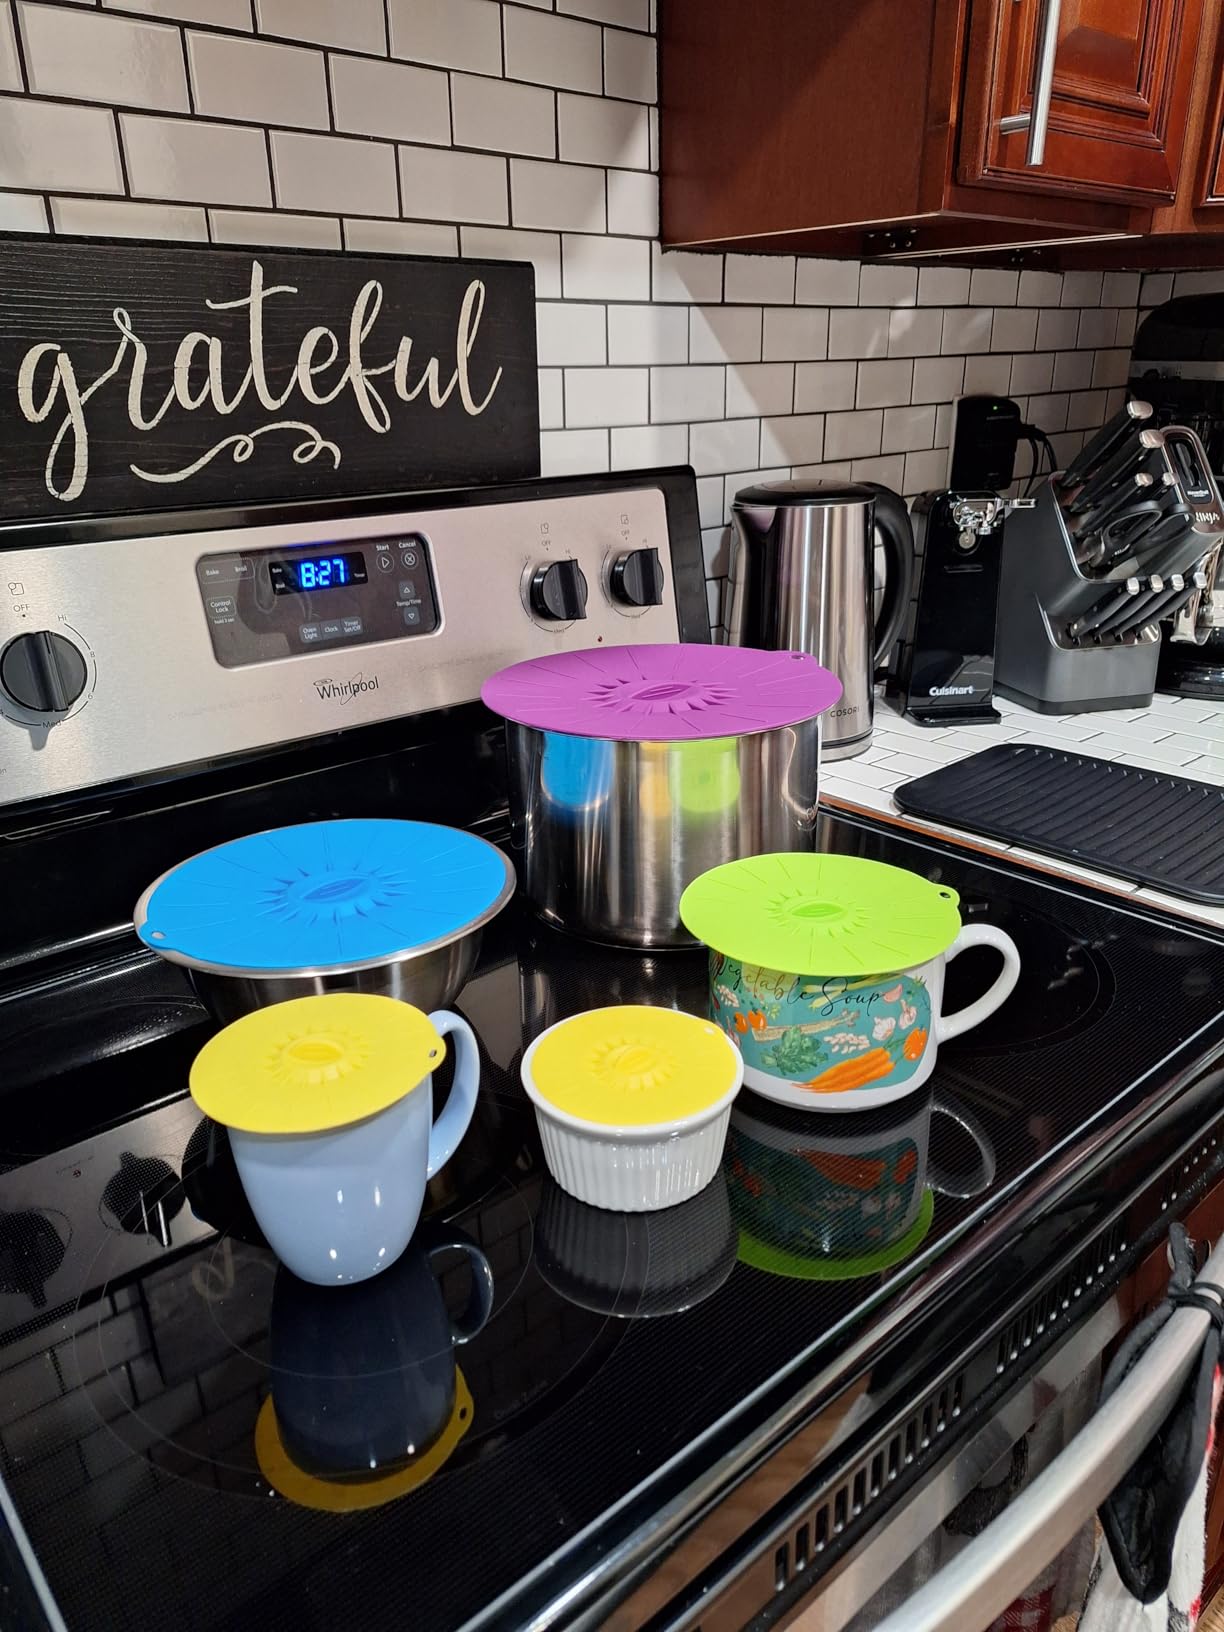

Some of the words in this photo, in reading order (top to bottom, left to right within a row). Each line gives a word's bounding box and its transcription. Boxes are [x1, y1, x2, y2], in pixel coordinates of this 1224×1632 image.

[18, 260, 502, 501] grateful
[398, 540, 417, 548] Cancel
[300, 558, 345, 588] 8:27
[13, 604, 30, 613] OFF
[210, 600, 232, 608] Control
[57, 614, 67, 622] Hi
[316, 675, 379, 700] Whirlpool
[929, 685, 974, 696] Cuisinart
[830, 706, 860, 718] COSORI
[42, 719, 62, 728] Med
[821, 976, 886, 1016] Soup
